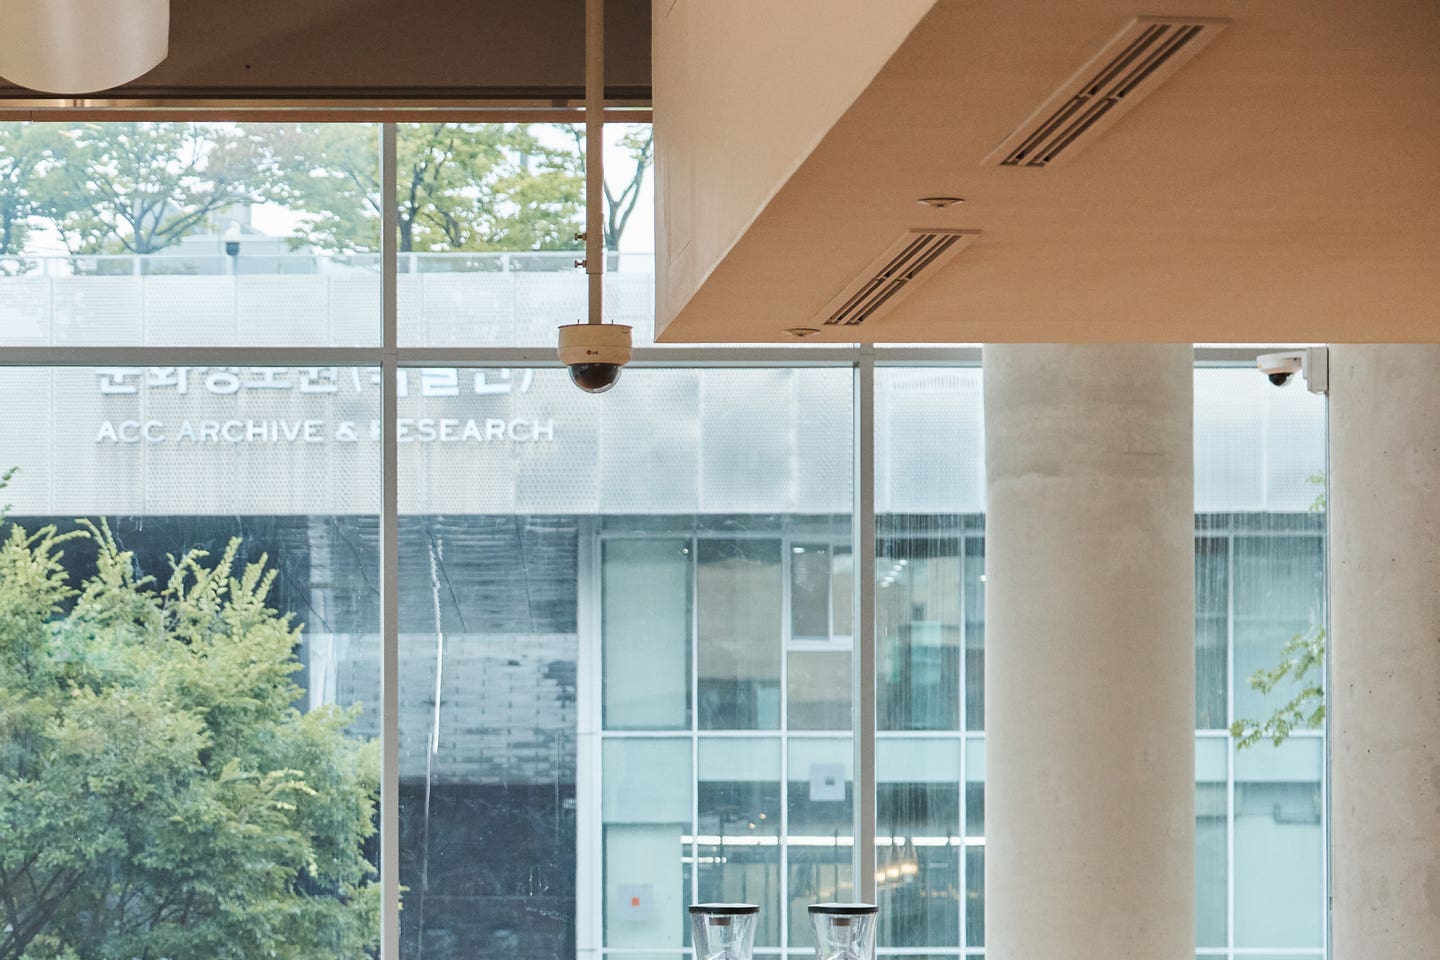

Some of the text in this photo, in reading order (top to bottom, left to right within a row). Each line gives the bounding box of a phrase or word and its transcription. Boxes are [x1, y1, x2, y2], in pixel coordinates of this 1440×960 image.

[95, 419, 165, 443] ACC
[177, 419, 325, 443] ARCHIVE
[335, 421, 358, 442] &
